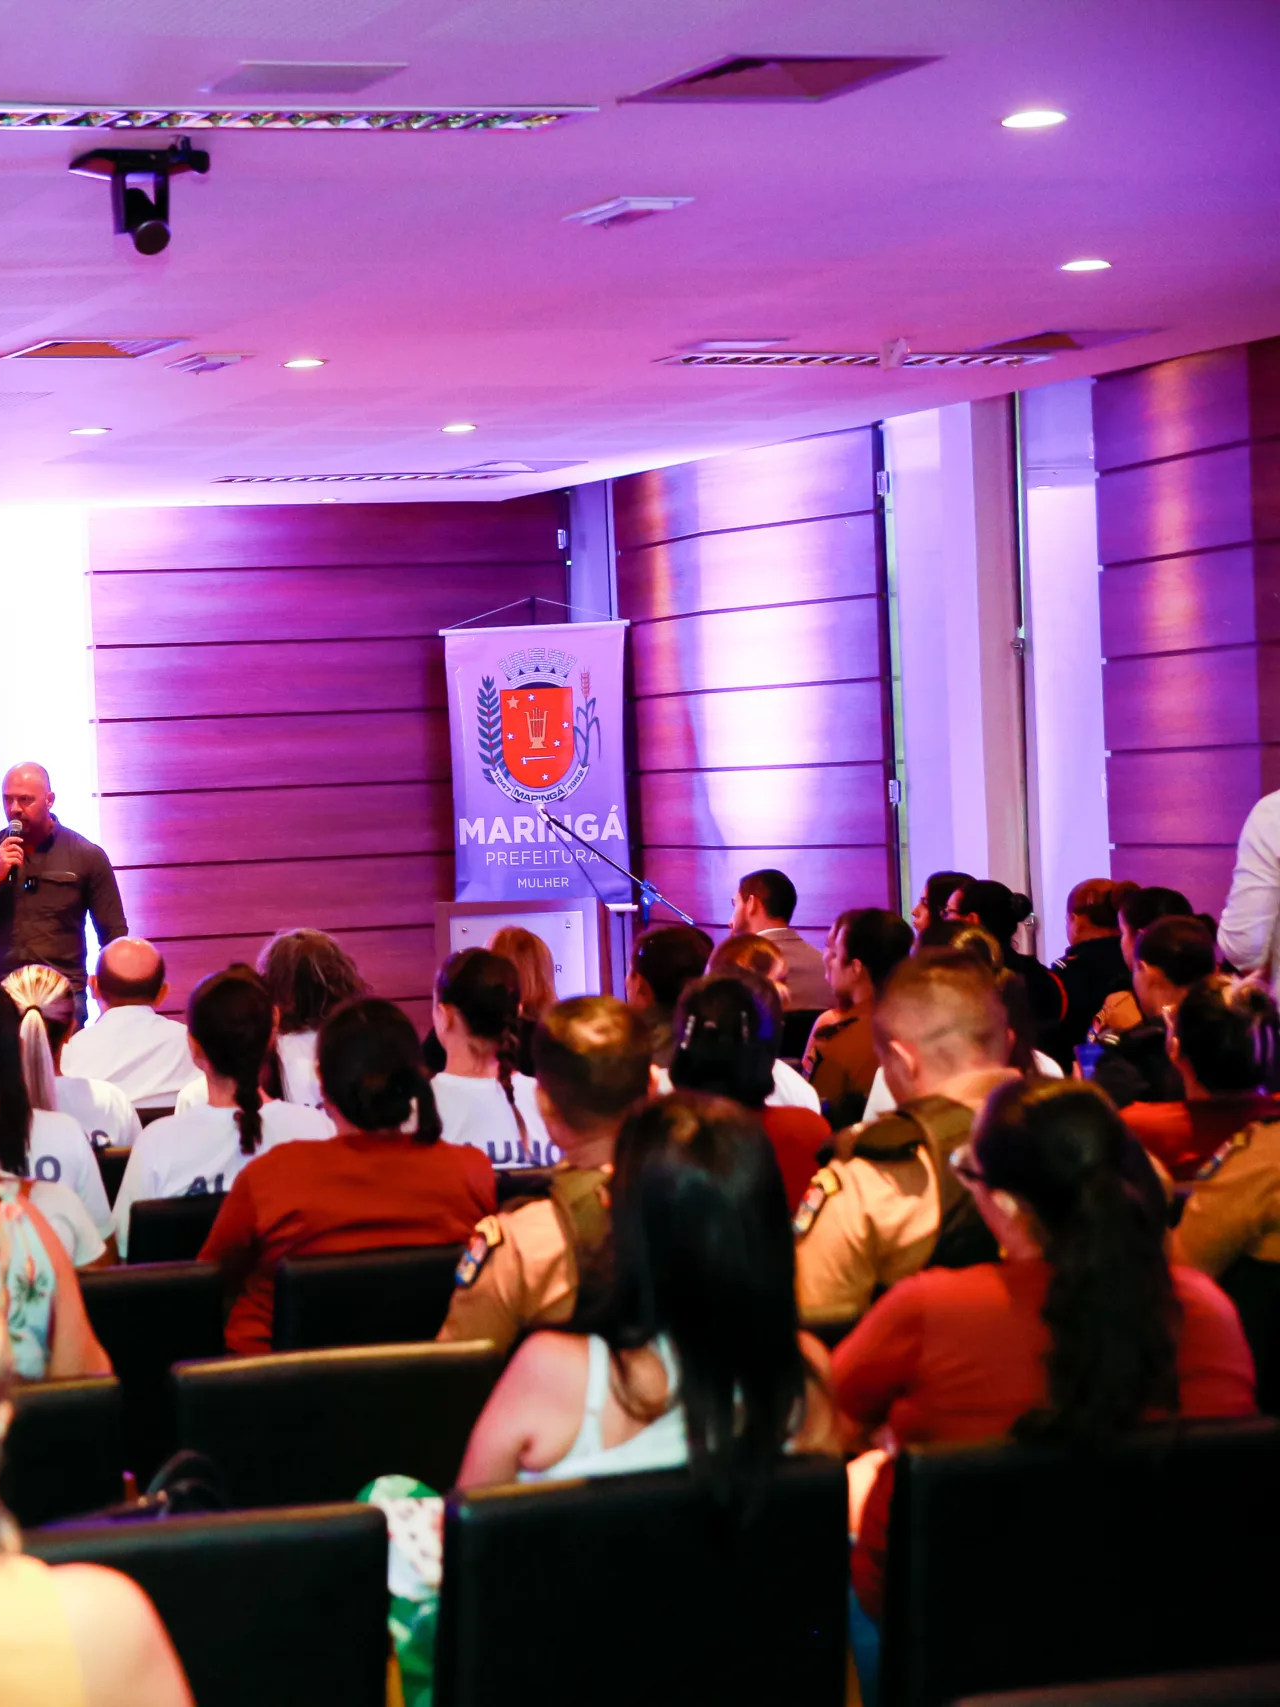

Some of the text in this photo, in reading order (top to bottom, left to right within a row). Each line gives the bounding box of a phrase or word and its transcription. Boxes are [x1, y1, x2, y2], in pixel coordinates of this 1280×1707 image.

[495, 772, 512, 792] 1947
[513, 787, 566, 802] MARINGÁ
[458, 804, 625, 846] MARINGÁ
[486, 849, 601, 866] PREFEITURA
[517, 877, 570, 889] MULHER
